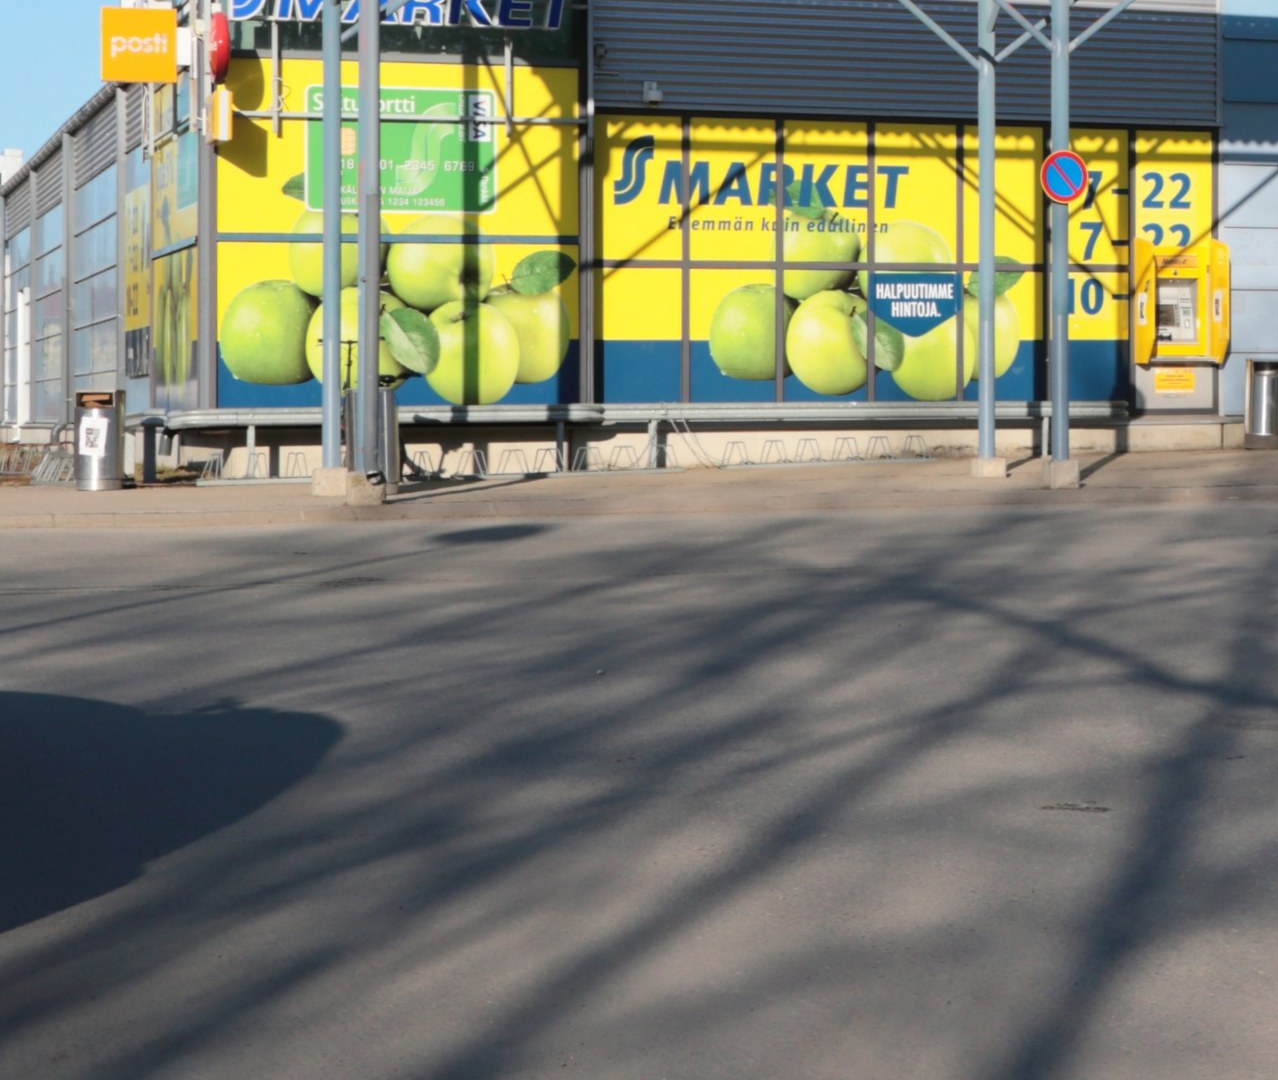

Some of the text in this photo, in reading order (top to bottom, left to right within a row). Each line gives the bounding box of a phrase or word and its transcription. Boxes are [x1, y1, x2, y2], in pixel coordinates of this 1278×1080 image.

[110, 33, 168, 59] posti
[657, 159, 910, 209] MARKET
[1141, 172, 1192, 209] 22
[1080, 221, 1104, 261] 7
[875, 283, 954, 300] HALPUUTIMME
[891, 301, 942, 318] HINTOJA.
